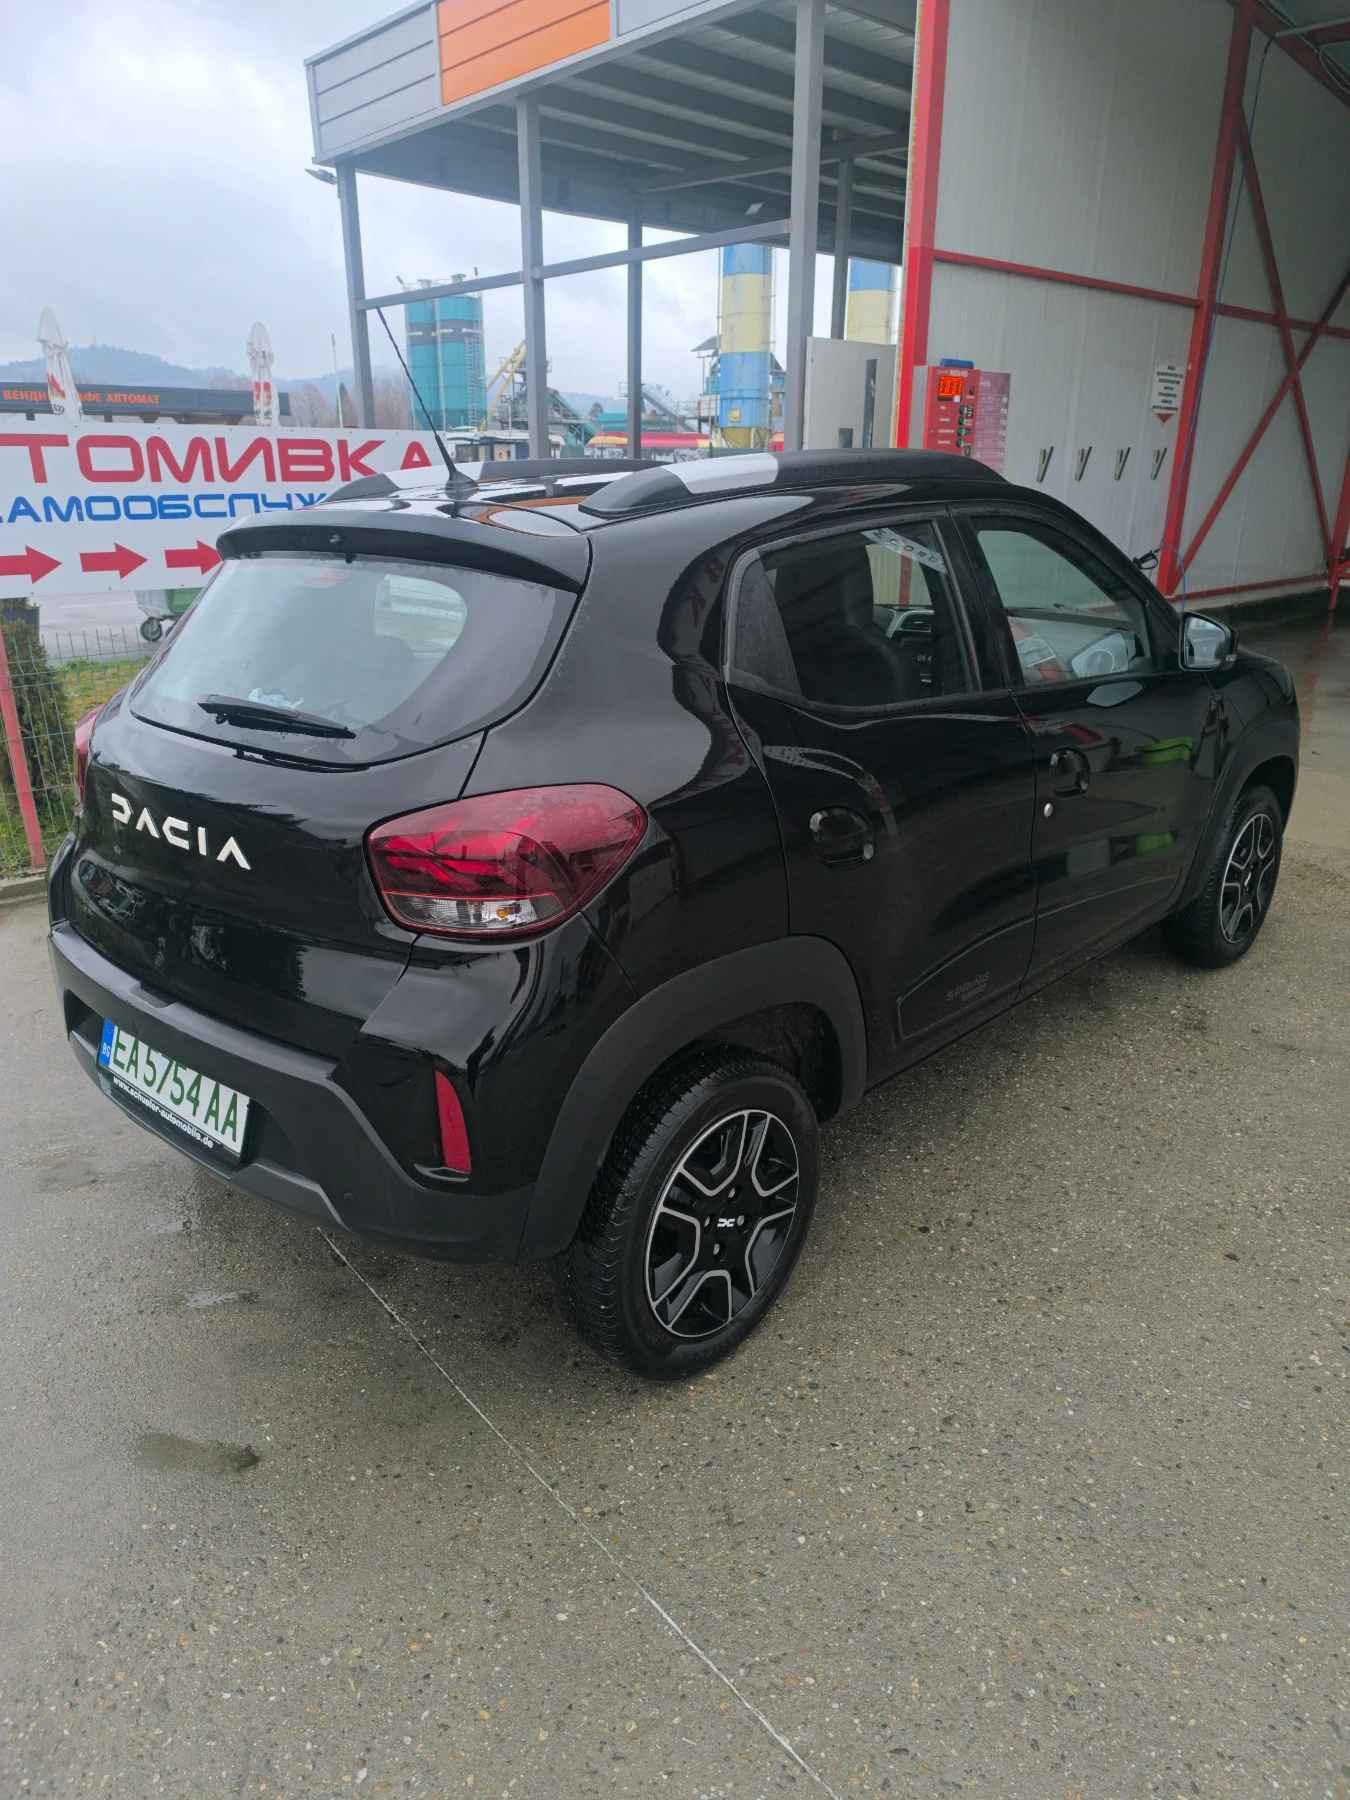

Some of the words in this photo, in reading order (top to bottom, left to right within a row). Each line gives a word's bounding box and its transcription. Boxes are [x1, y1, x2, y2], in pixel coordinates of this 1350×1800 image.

[3, 390, 49, 402] ВЕНДИ
[106, 394, 160, 405] АВТОМАТ
[0, 493, 327, 523] АМООБСЛУЖ
[111, 793, 252, 870] DACIA
[946, 971, 989, 1001] SPRING
[102, 1043, 111, 1058] BG
[113, 1029, 140, 1080] EA
[143, 1047, 203, 1117] 5754
[204, 1082, 238, 1142] AA
[113, 1076, 213, 1149] www.schuster-automobile.de
